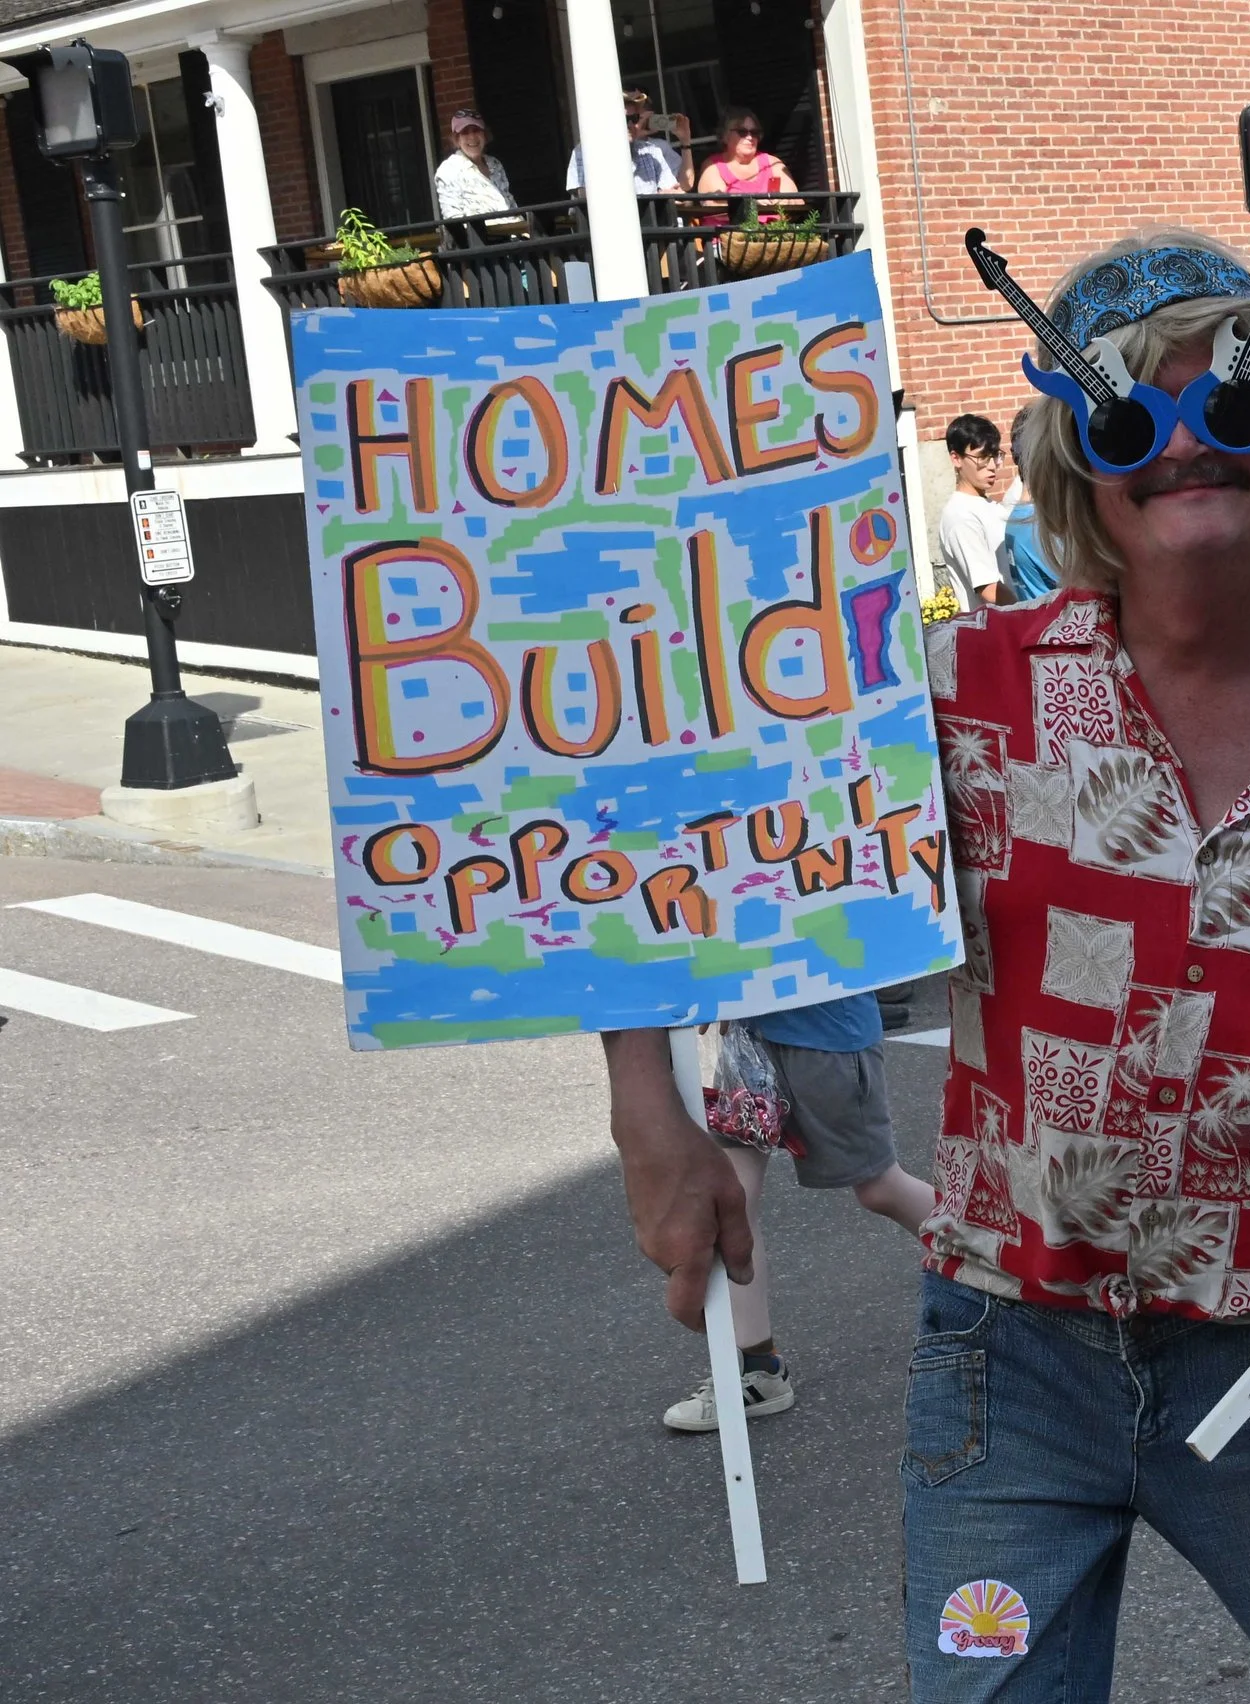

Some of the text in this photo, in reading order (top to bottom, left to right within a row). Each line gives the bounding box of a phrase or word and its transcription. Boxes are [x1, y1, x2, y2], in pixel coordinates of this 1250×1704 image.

[347, 321, 879, 513] HOMES
[361, 775, 948, 938] OPPORTUNITY
[951, 1629, 1016, 1656] Groovy
